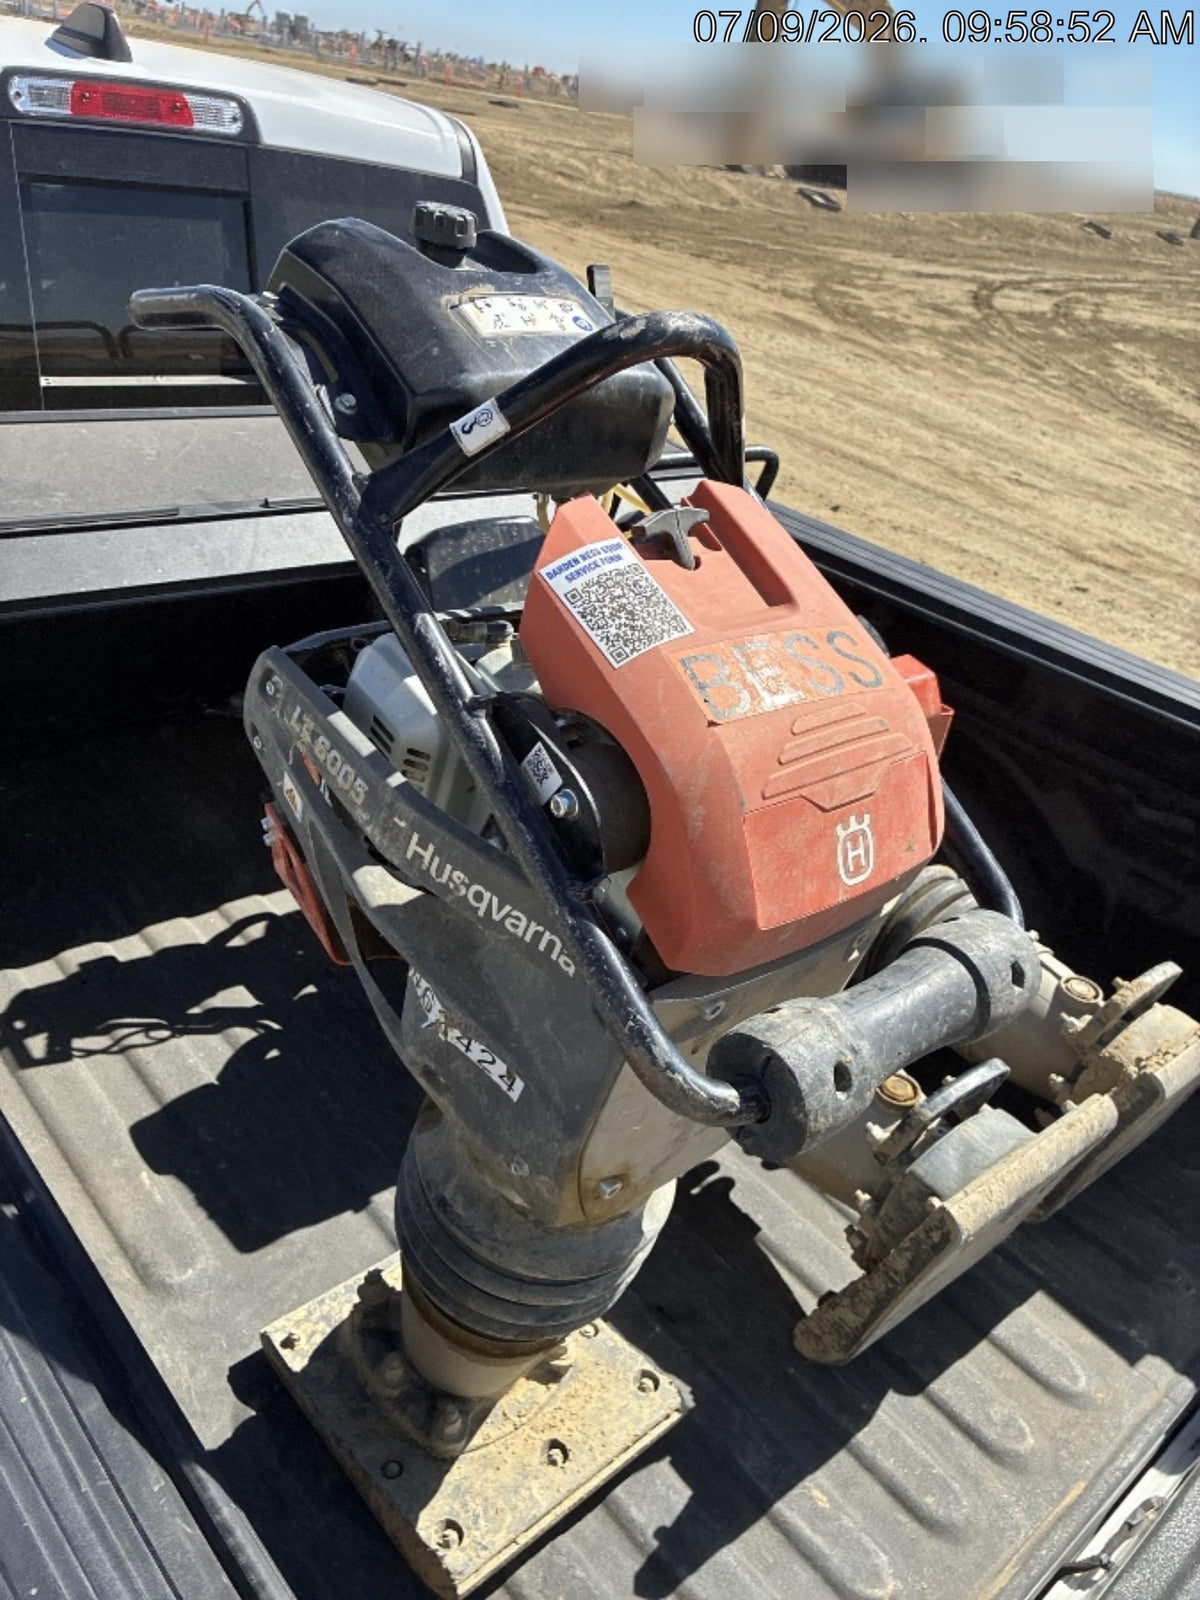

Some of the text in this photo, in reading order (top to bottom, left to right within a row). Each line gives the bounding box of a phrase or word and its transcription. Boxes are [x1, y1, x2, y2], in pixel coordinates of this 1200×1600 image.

[564, 554, 623, 583] SERVICE FORM
[678, 629, 883, 721] BESS
[405, 831, 576, 978] Husqvarna
